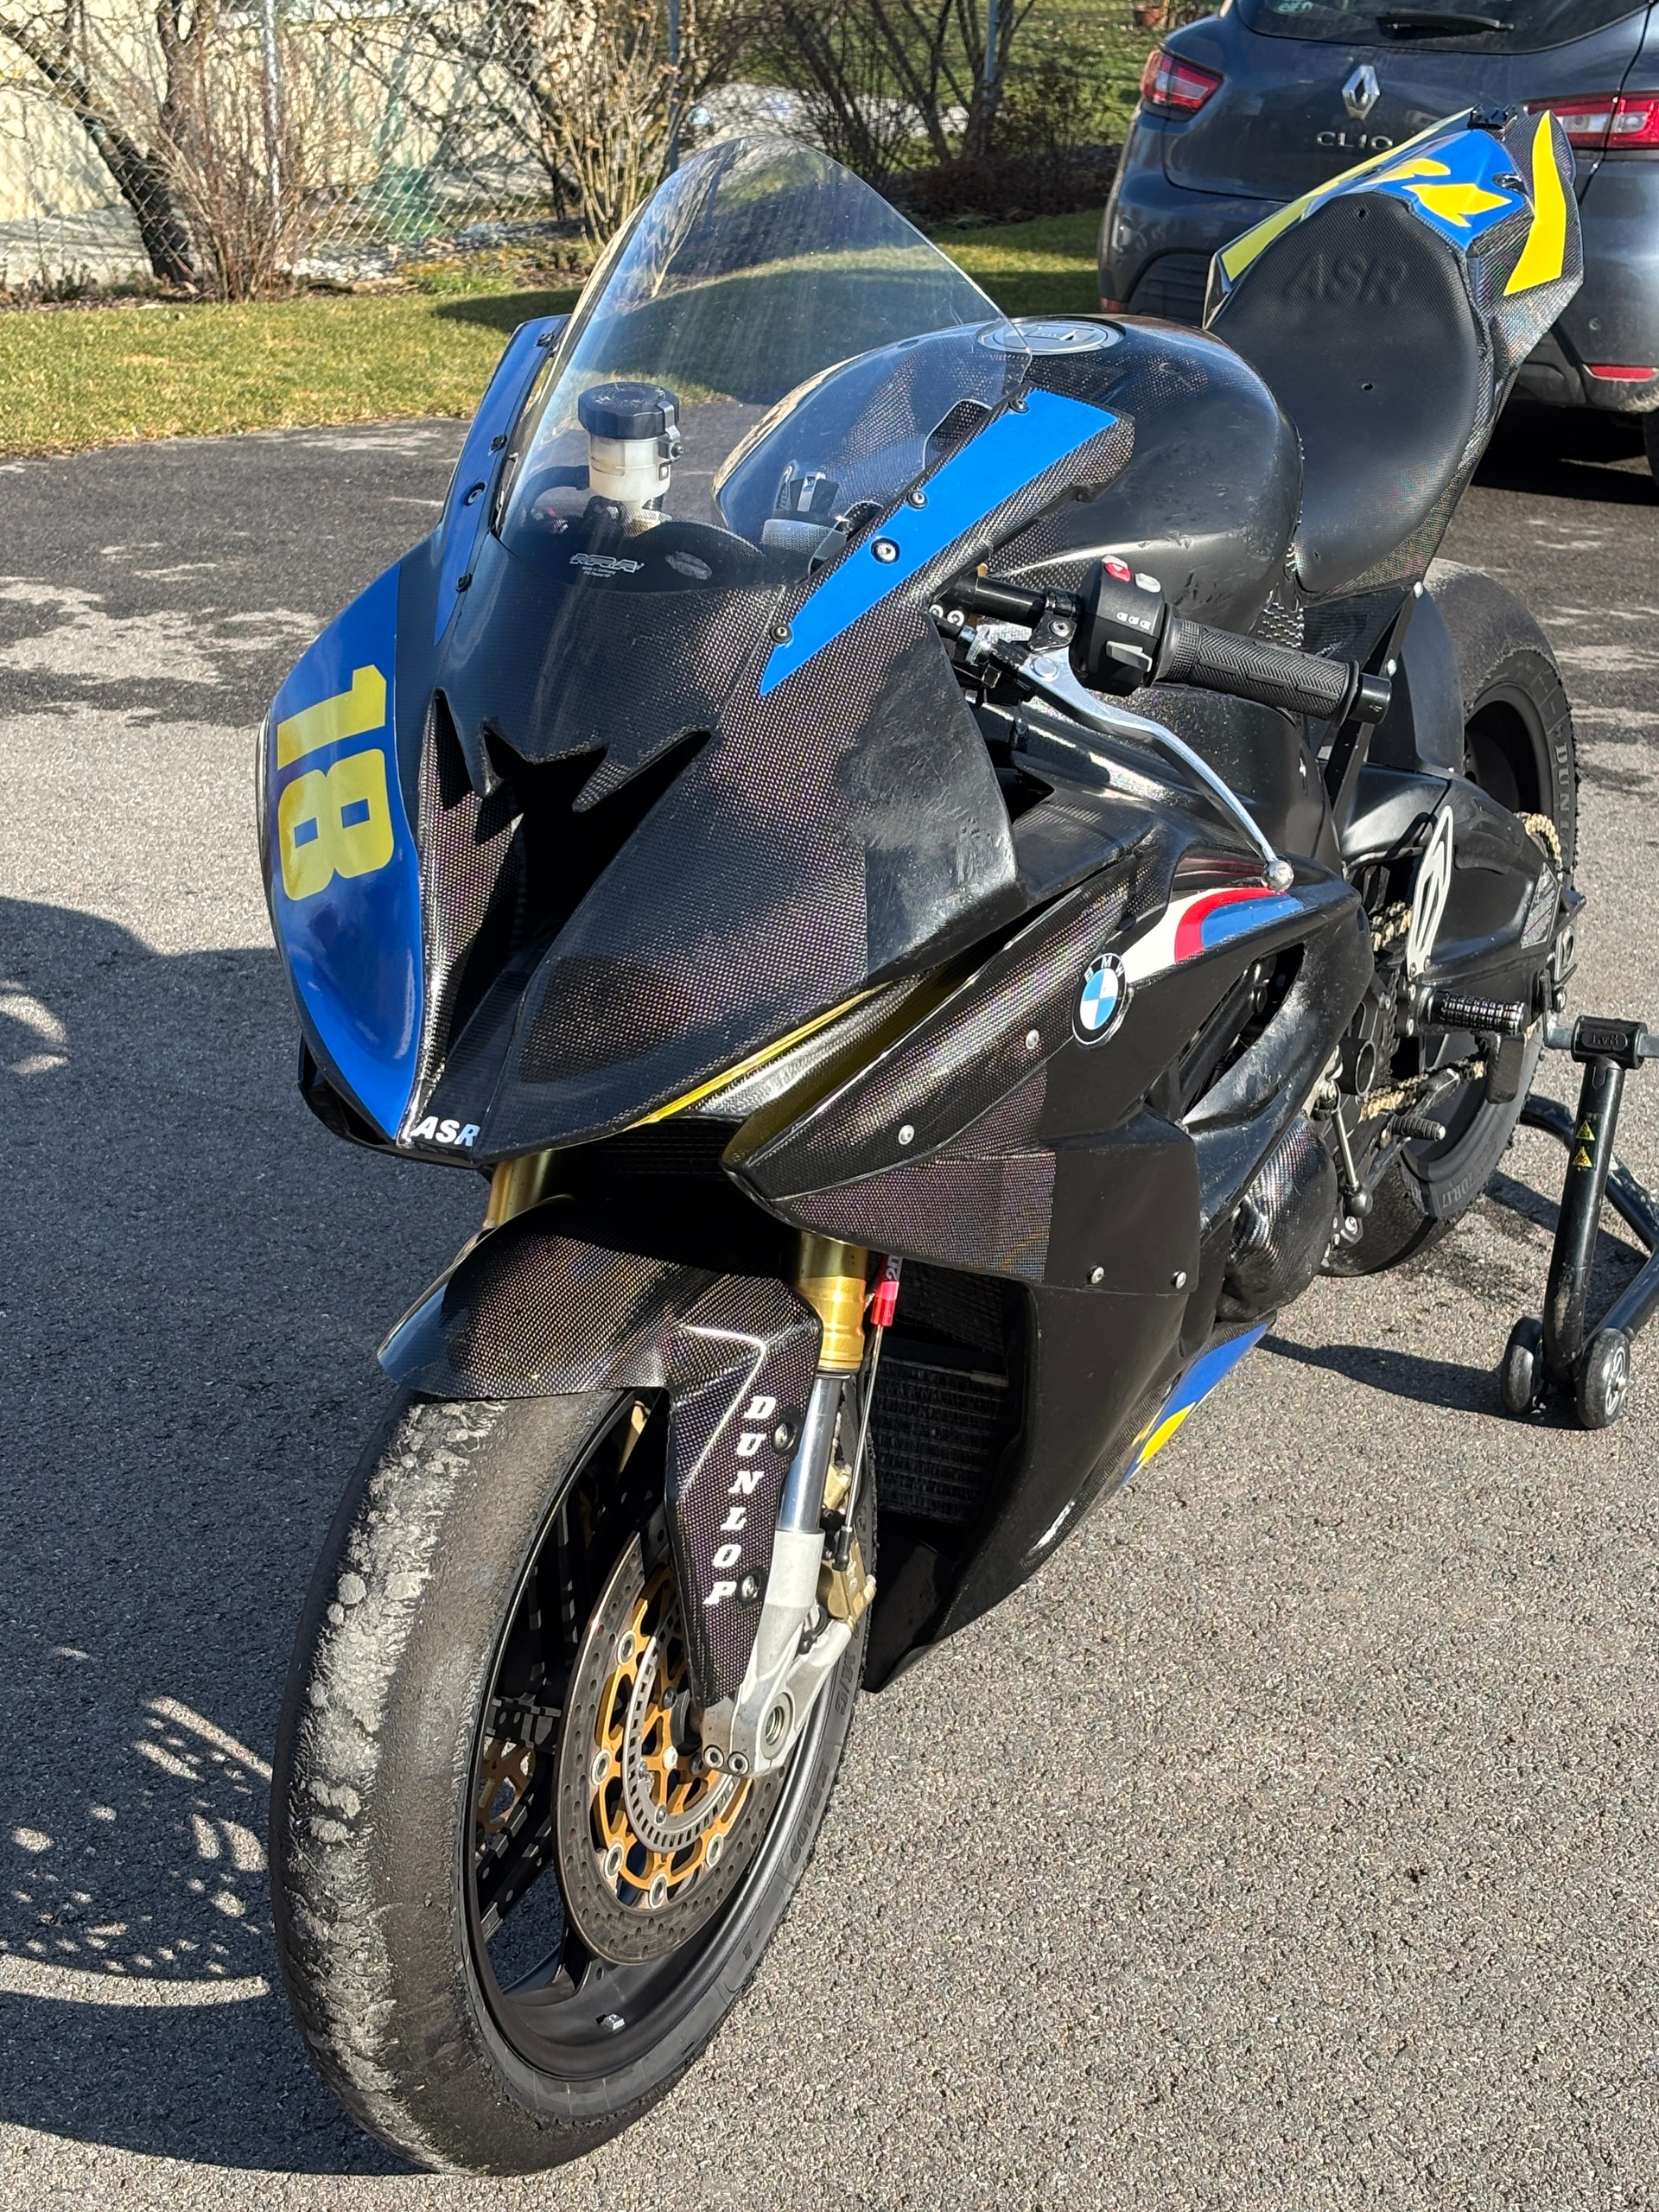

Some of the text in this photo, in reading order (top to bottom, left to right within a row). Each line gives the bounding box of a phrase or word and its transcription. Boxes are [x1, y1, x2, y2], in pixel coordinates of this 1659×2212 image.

[1316, 131, 1394, 150] CLIO
[277, 664, 394, 900] 18
[1084, 955, 1124, 983] BMW
[410, 1116, 480, 1147] ASR
[703, 1395, 776, 1605] DUNLOP
